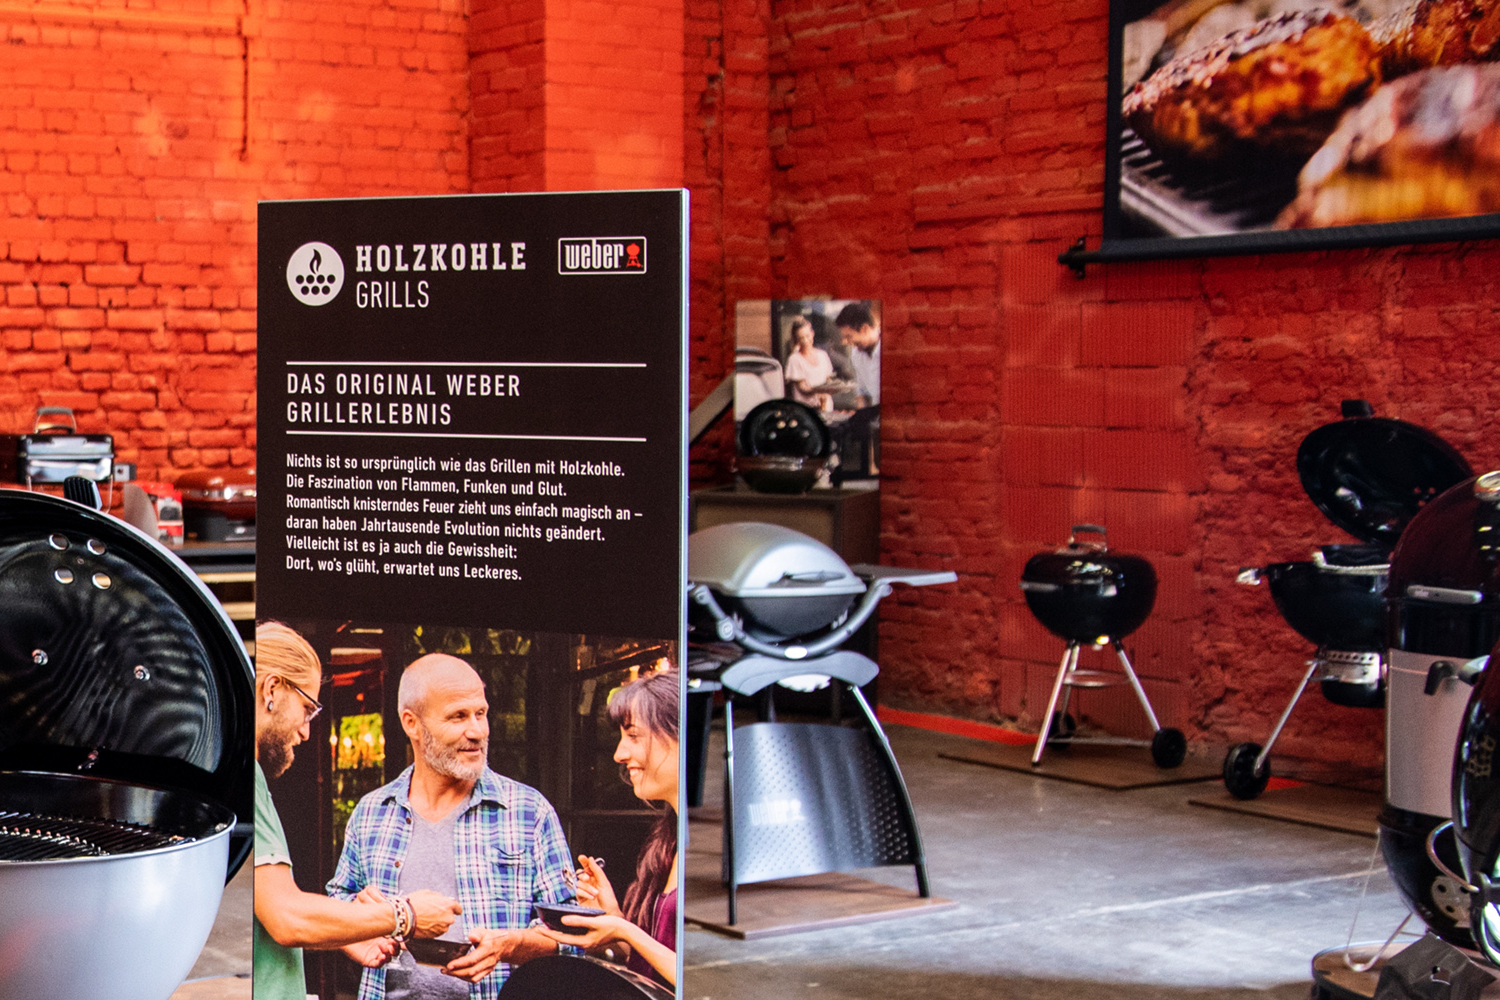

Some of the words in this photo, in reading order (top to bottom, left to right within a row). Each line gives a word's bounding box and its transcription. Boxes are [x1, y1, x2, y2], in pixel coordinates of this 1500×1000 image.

[355, 242, 526, 272] HOLZKOHLE
[564, 240, 624, 269] weber
[356, 280, 429, 309] GRILLS
[287, 373, 325, 395] DAS
[336, 373, 436, 396] ORIGINAL
[446, 374, 520, 397] WEBER
[287, 401, 451, 425] GRILLERLEBNIS
[286, 453, 322, 468] Nichts
[326, 454, 341, 469] ist
[344, 458, 358, 469] so
[361, 455, 436, 474] ursprünglich
[440, 457, 461, 472] wie
[465, 457, 487, 473] das
[490, 458, 531, 474] Grillen
[535, 459, 556, 475] mit
[559, 460, 625, 477] Holzkohle.
[286, 473, 304, 488] Die
[308, 474, 373, 490] Faszination
[376, 479, 398, 491] von
[401, 476, 460, 494] Flammen,
[463, 478, 507, 494] Funken
[511, 480, 534, 495] und
[537, 480, 567, 497] Glut.
[286, 494, 350, 510] Romantisch
[353, 496, 420, 513] knisterndes
[423, 498, 455, 514] Feuer
[458, 500, 487, 515] zieht
[490, 504, 512, 516] uns
[514, 501, 558, 518] einfach
[561, 504, 612, 522] magisch
[615, 508, 631, 521] an
[286, 514, 319, 530] daran
[322, 515, 357, 531] haben
[360, 517, 441, 535] Jahrtausende
[444, 520, 500, 537] Evolution
[504, 522, 542, 539] nichts
[545, 524, 605, 542] geändert.
[285, 534, 340, 551] Vielleicht
[343, 537, 359, 552] ist
[362, 541, 376, 553] es
[378, 538, 390, 556] ja
[393, 540, 422, 555] auch
[425, 540, 444, 556] die
[448, 541, 517, 559] Gewissheit:
[286, 555, 314, 572] Dort,
[345, 558, 380, 576] glüht,
[383, 562, 435, 576] erwartet
[438, 565, 460, 578] uns
[464, 563, 522, 581] Leckeres.
